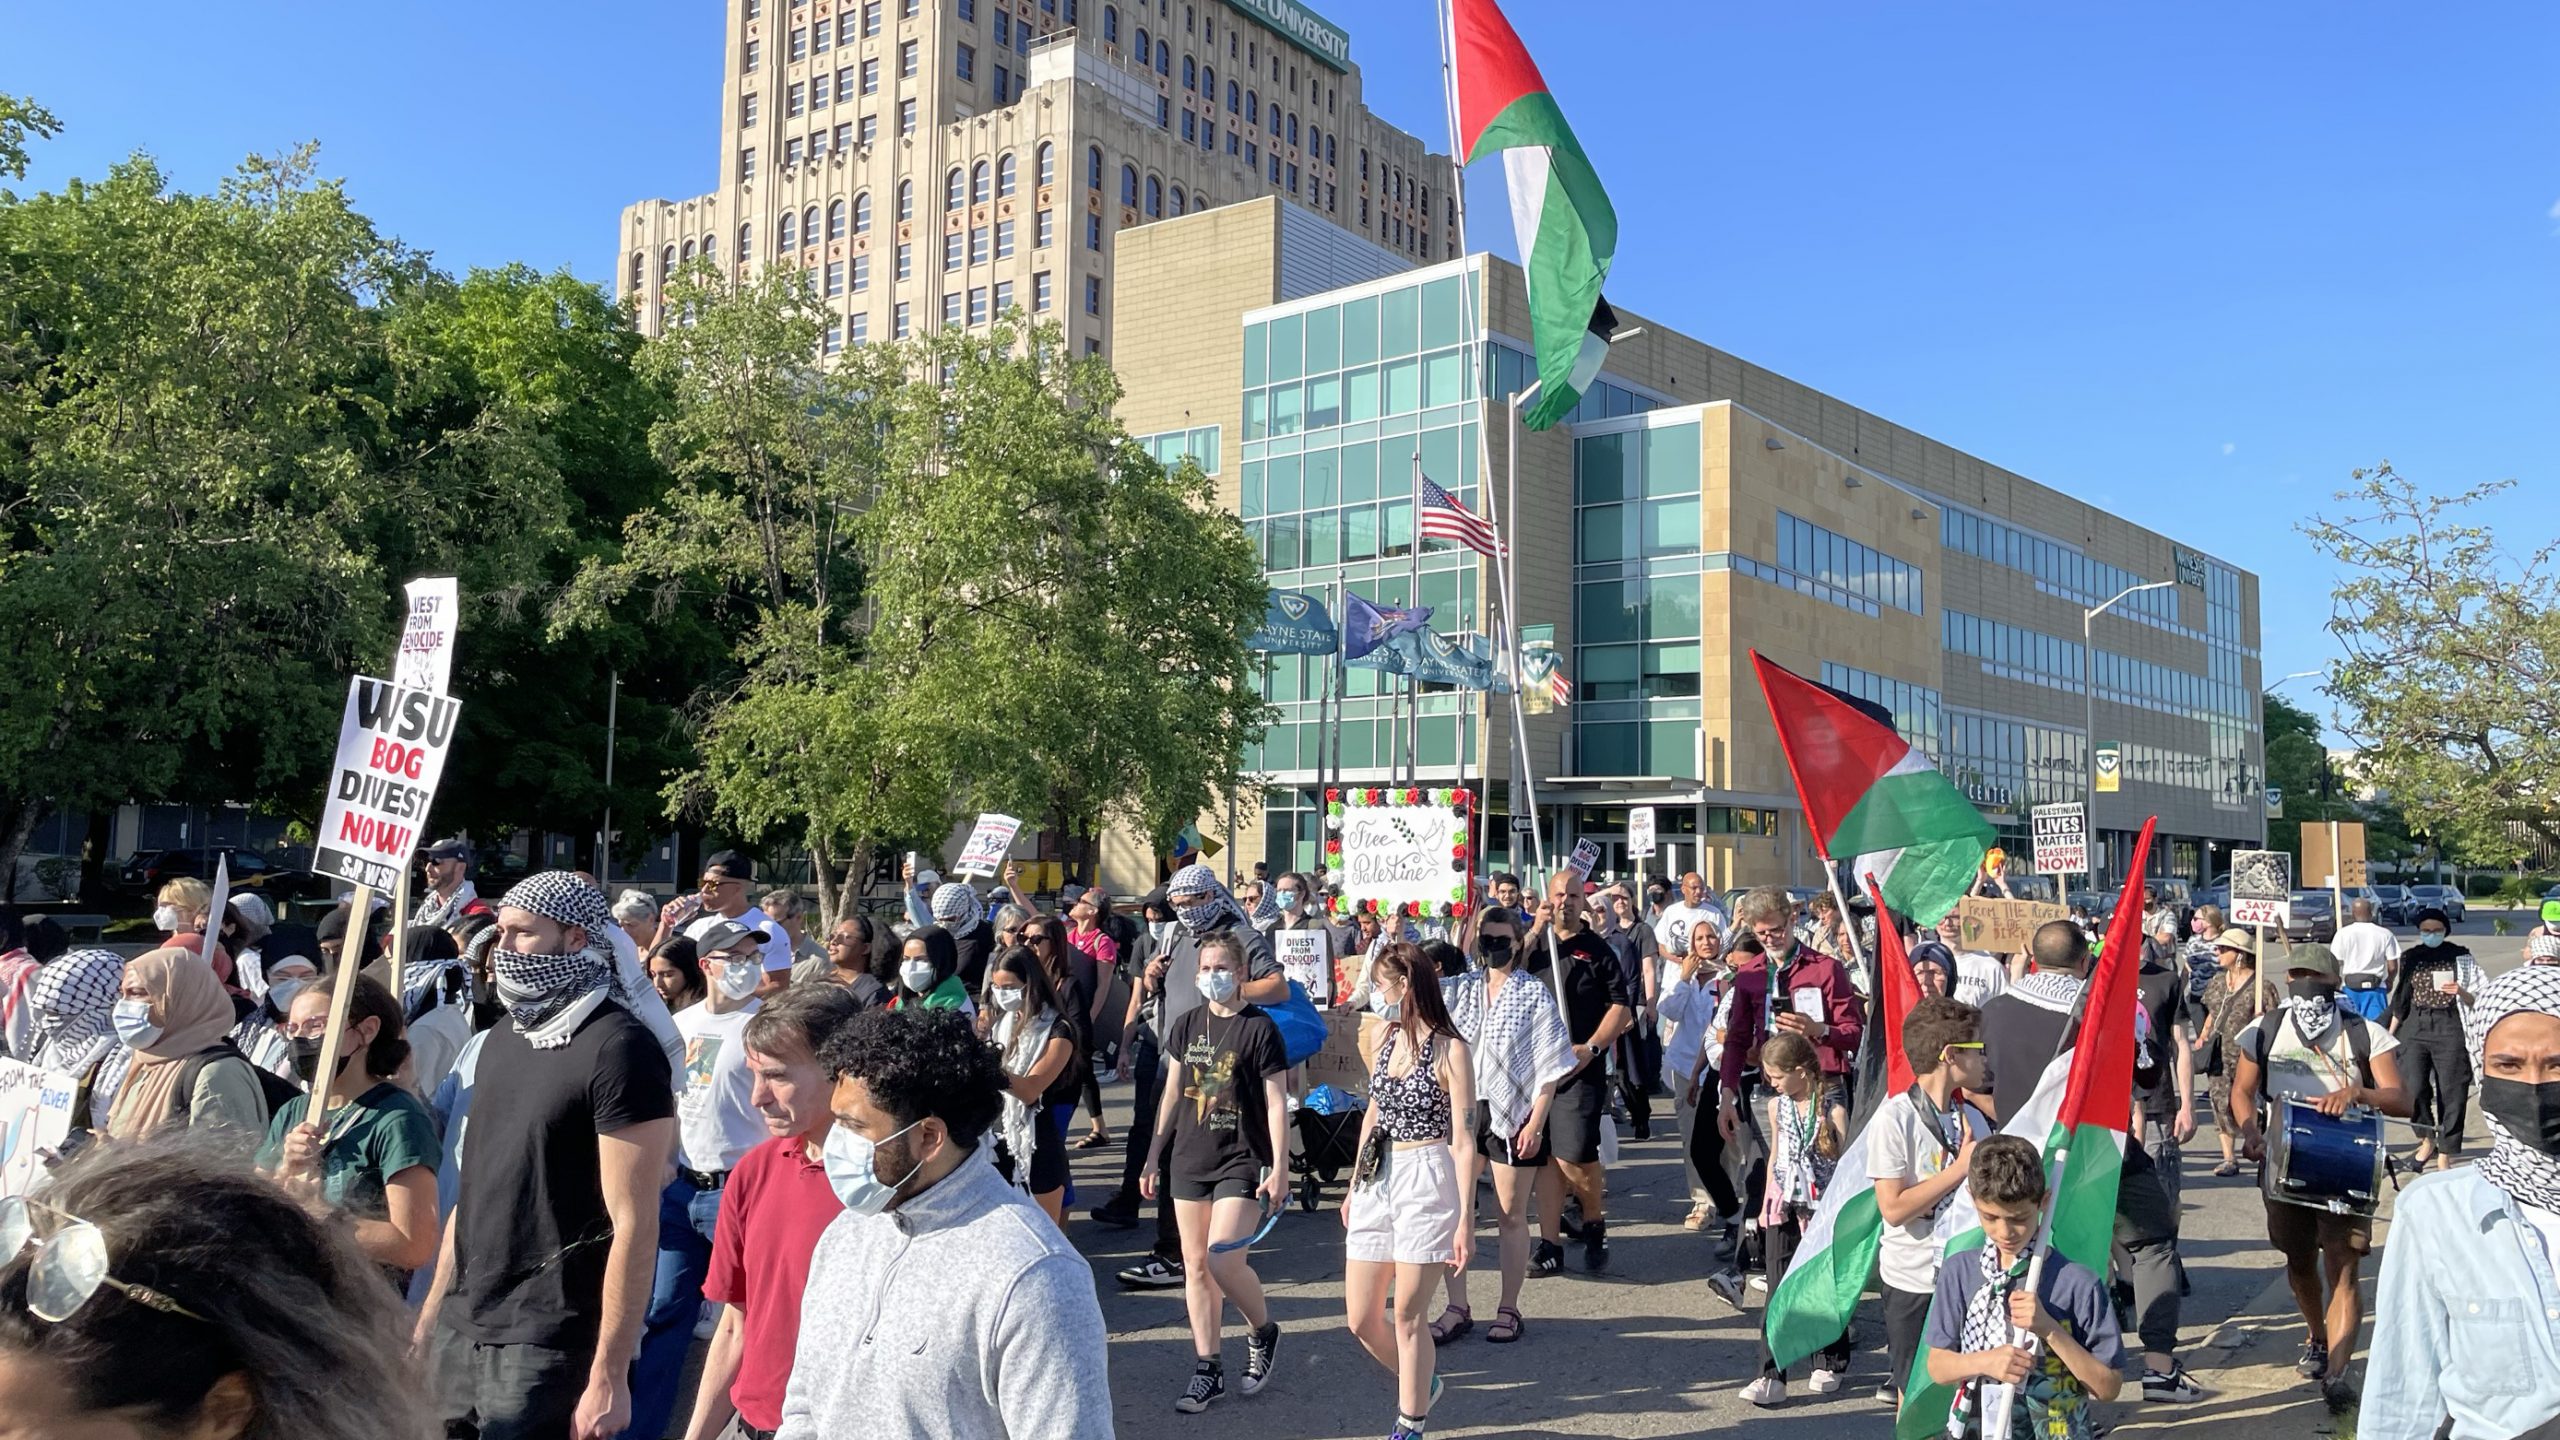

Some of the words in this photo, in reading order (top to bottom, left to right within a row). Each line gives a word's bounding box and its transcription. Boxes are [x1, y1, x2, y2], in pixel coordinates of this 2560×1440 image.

[1268, 0, 1348, 61] UNIVERSITY
[409, 615, 433, 631] FROM
[1264, 636, 1322, 649] UNIVERSITY
[358, 679, 456, 748] WSU
[370, 737, 425, 779] BOG
[338, 769, 429, 821] DIVEST
[1968, 783, 2013, 804] CENTER
[2034, 805, 2082, 816] PALESTINIAN
[2037, 817, 2080, 834] LIVES
[339, 811, 412, 858] NOW!
[1349, 819, 1397, 849] Free
[2037, 835, 2083, 846] MATTER
[1579, 838, 1600, 858] WSU
[2037, 846, 2084, 857] CEASEFIRE
[1352, 852, 1438, 886] Palestine
[1571, 857, 1591, 871] DIVEST
[2038, 857, 2084, 871] NOW!
[2002, 902, 2028, 918] THE
[2245, 901, 2275, 910] SAVE
[2236, 909, 2276, 923] GAZ
[1286, 938, 1315, 947] DIVEST
[1282, 954, 1321, 964] GENOCIDE
[28, 1072, 47, 1091] THE
